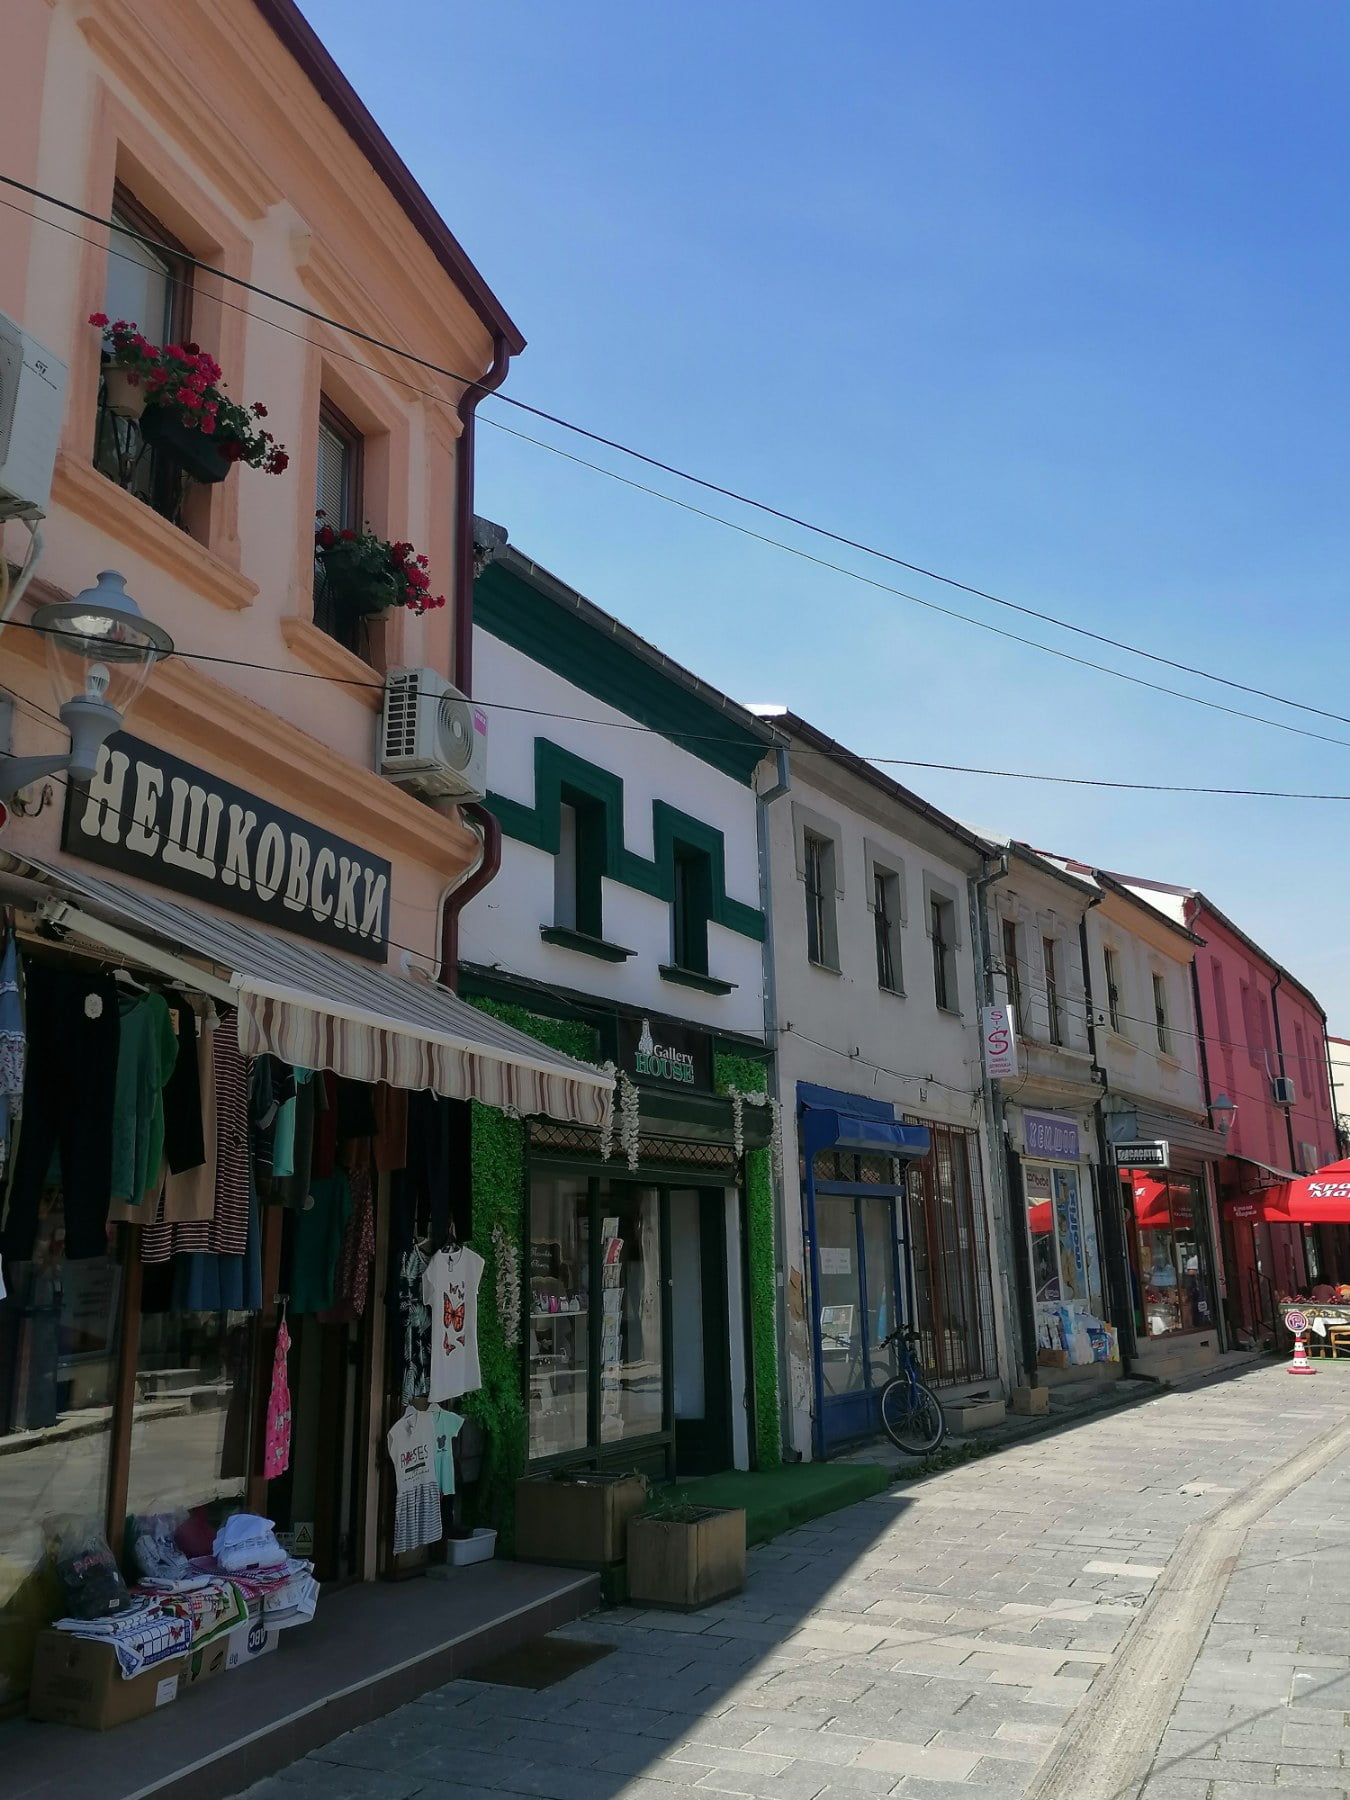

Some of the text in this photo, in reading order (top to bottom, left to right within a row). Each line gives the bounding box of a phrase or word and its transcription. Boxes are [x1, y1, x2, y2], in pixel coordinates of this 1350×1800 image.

[81, 744, 387, 943] НЕШКОВСКИ
[634, 1051, 695, 1085] HOUSE
[653, 1044, 694, 1065] Gallery
